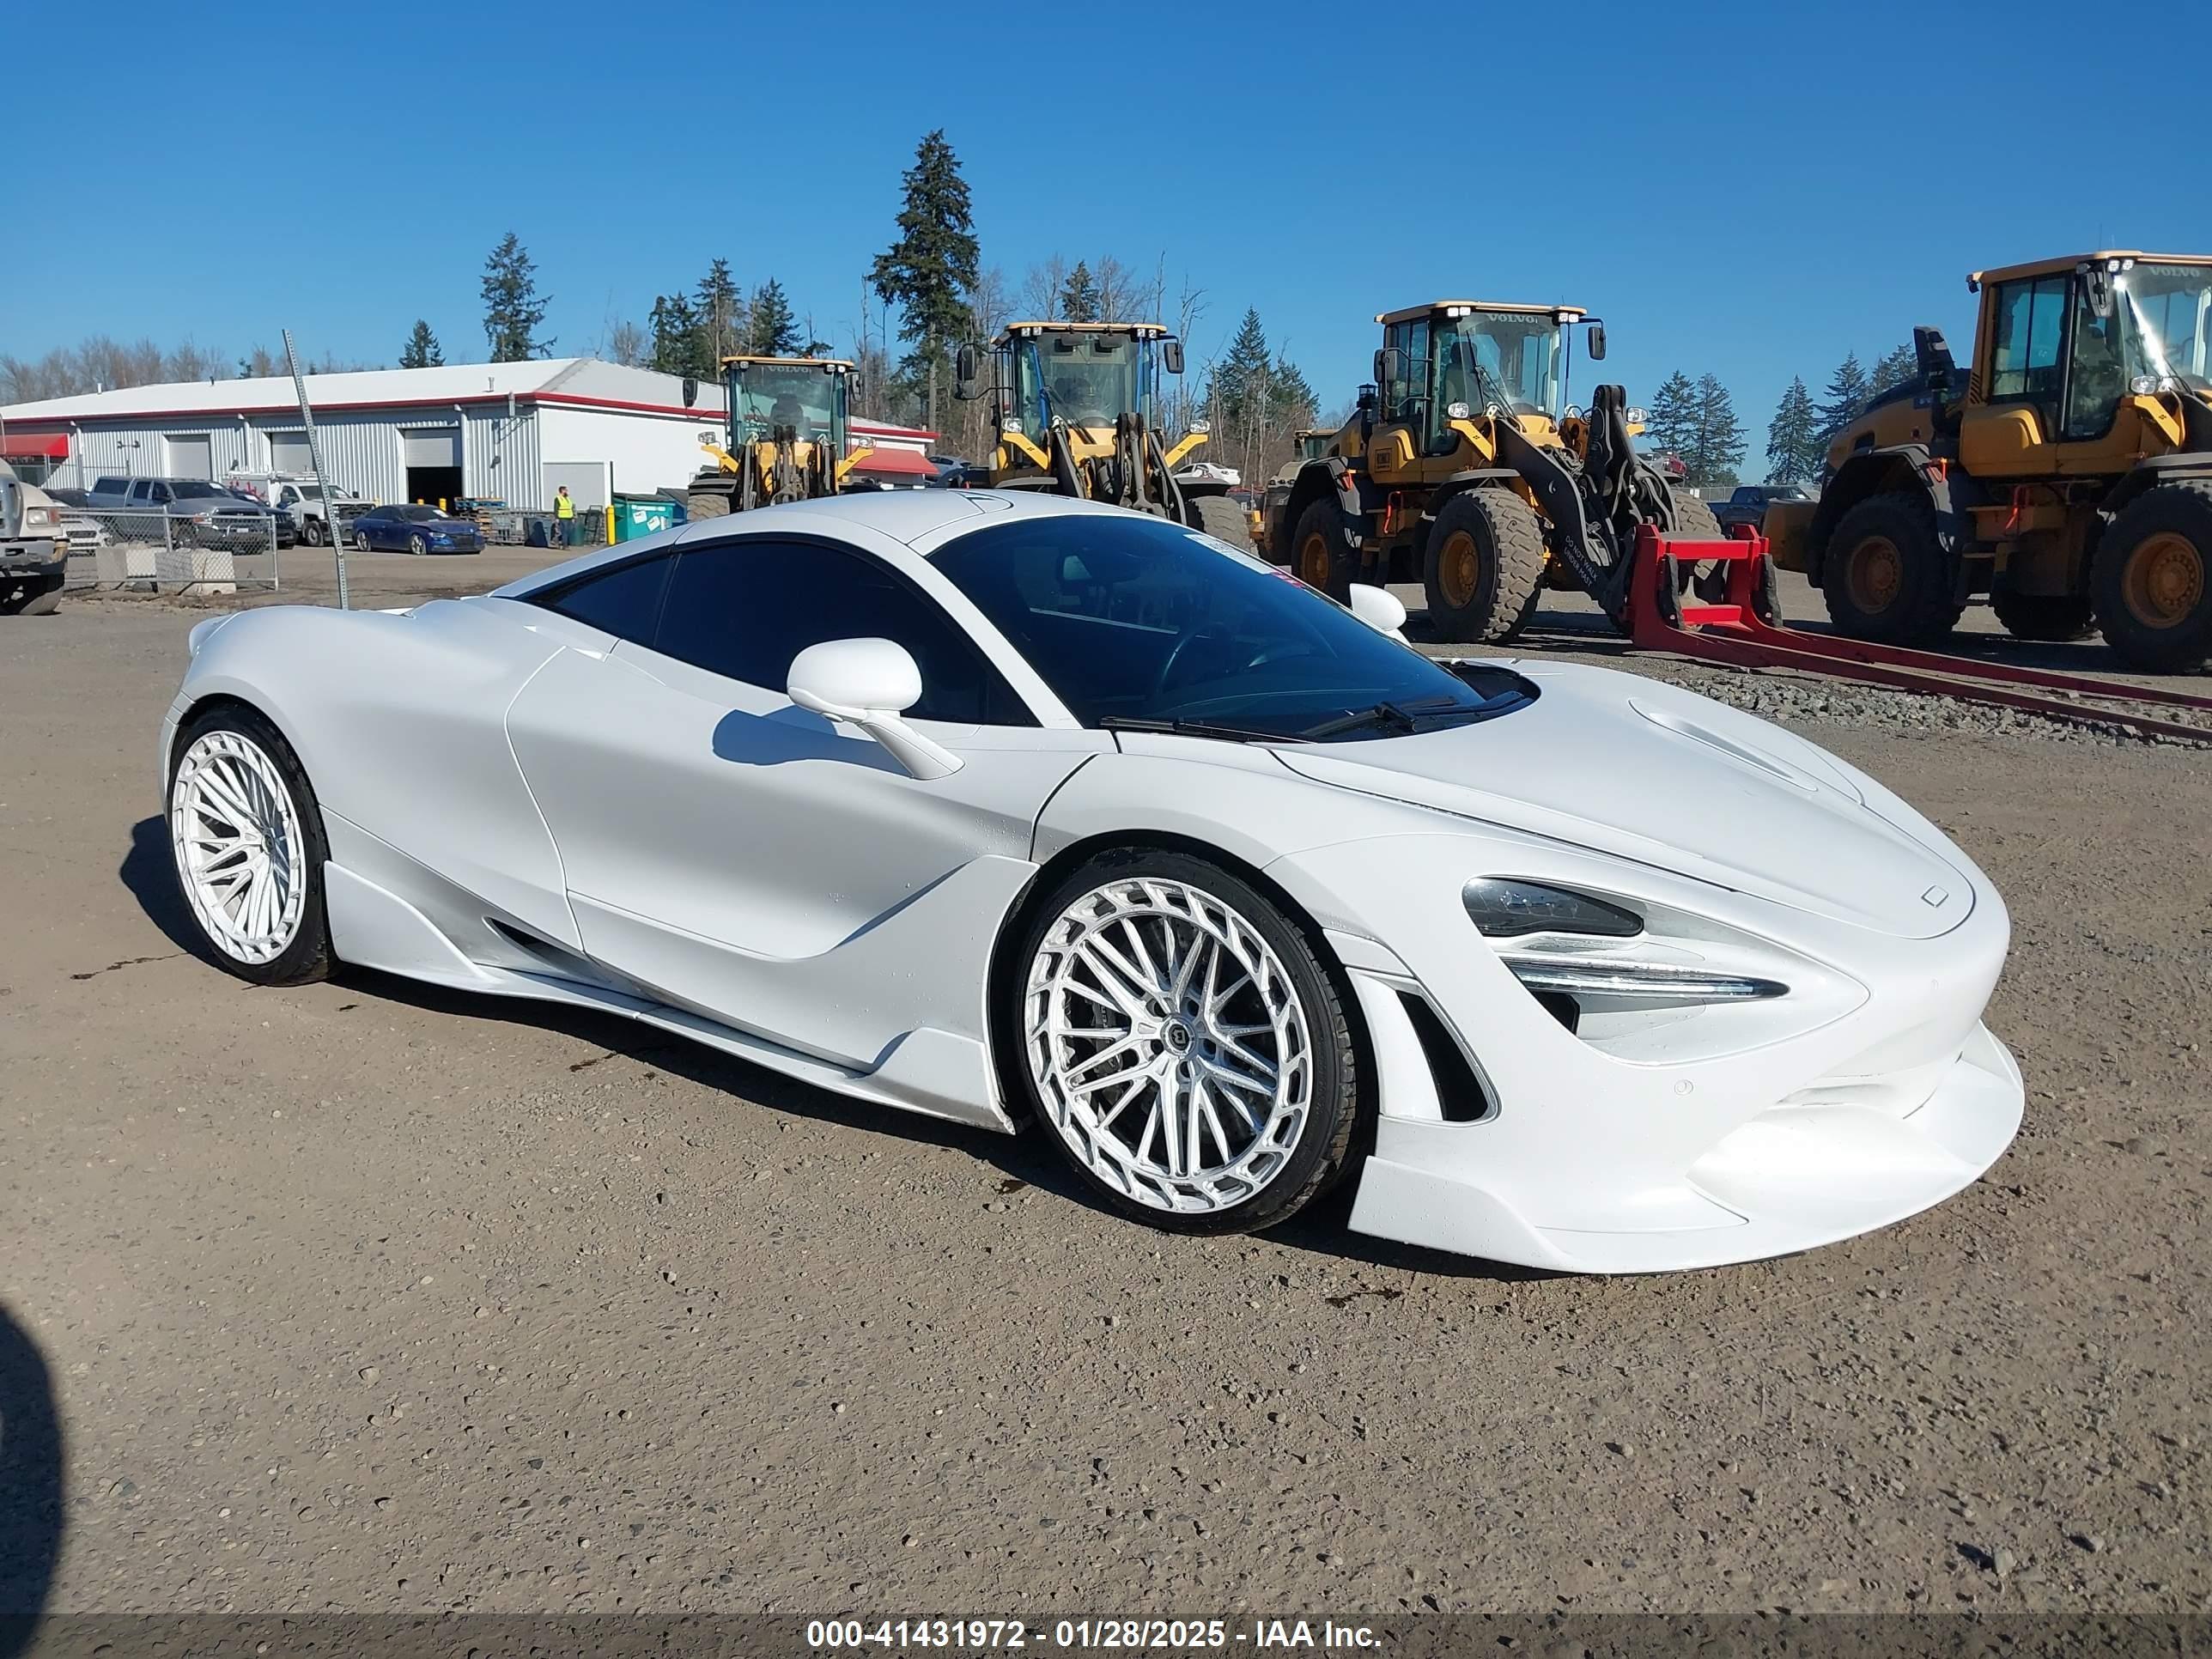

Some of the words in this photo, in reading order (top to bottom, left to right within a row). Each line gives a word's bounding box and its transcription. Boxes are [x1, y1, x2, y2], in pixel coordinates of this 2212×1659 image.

[2148, 266, 2200, 277] VOLVO
[1486, 313, 1535, 324] VOLVO
[767, 365, 808, 374] VOLVO
[1565, 535, 1574, 548] DO
[1573, 544, 1585, 562] NOT
[1583, 559, 1598, 582] WALK
[1564, 546, 1580, 571] UNDER
[1578, 567, 1593, 587] MAST
